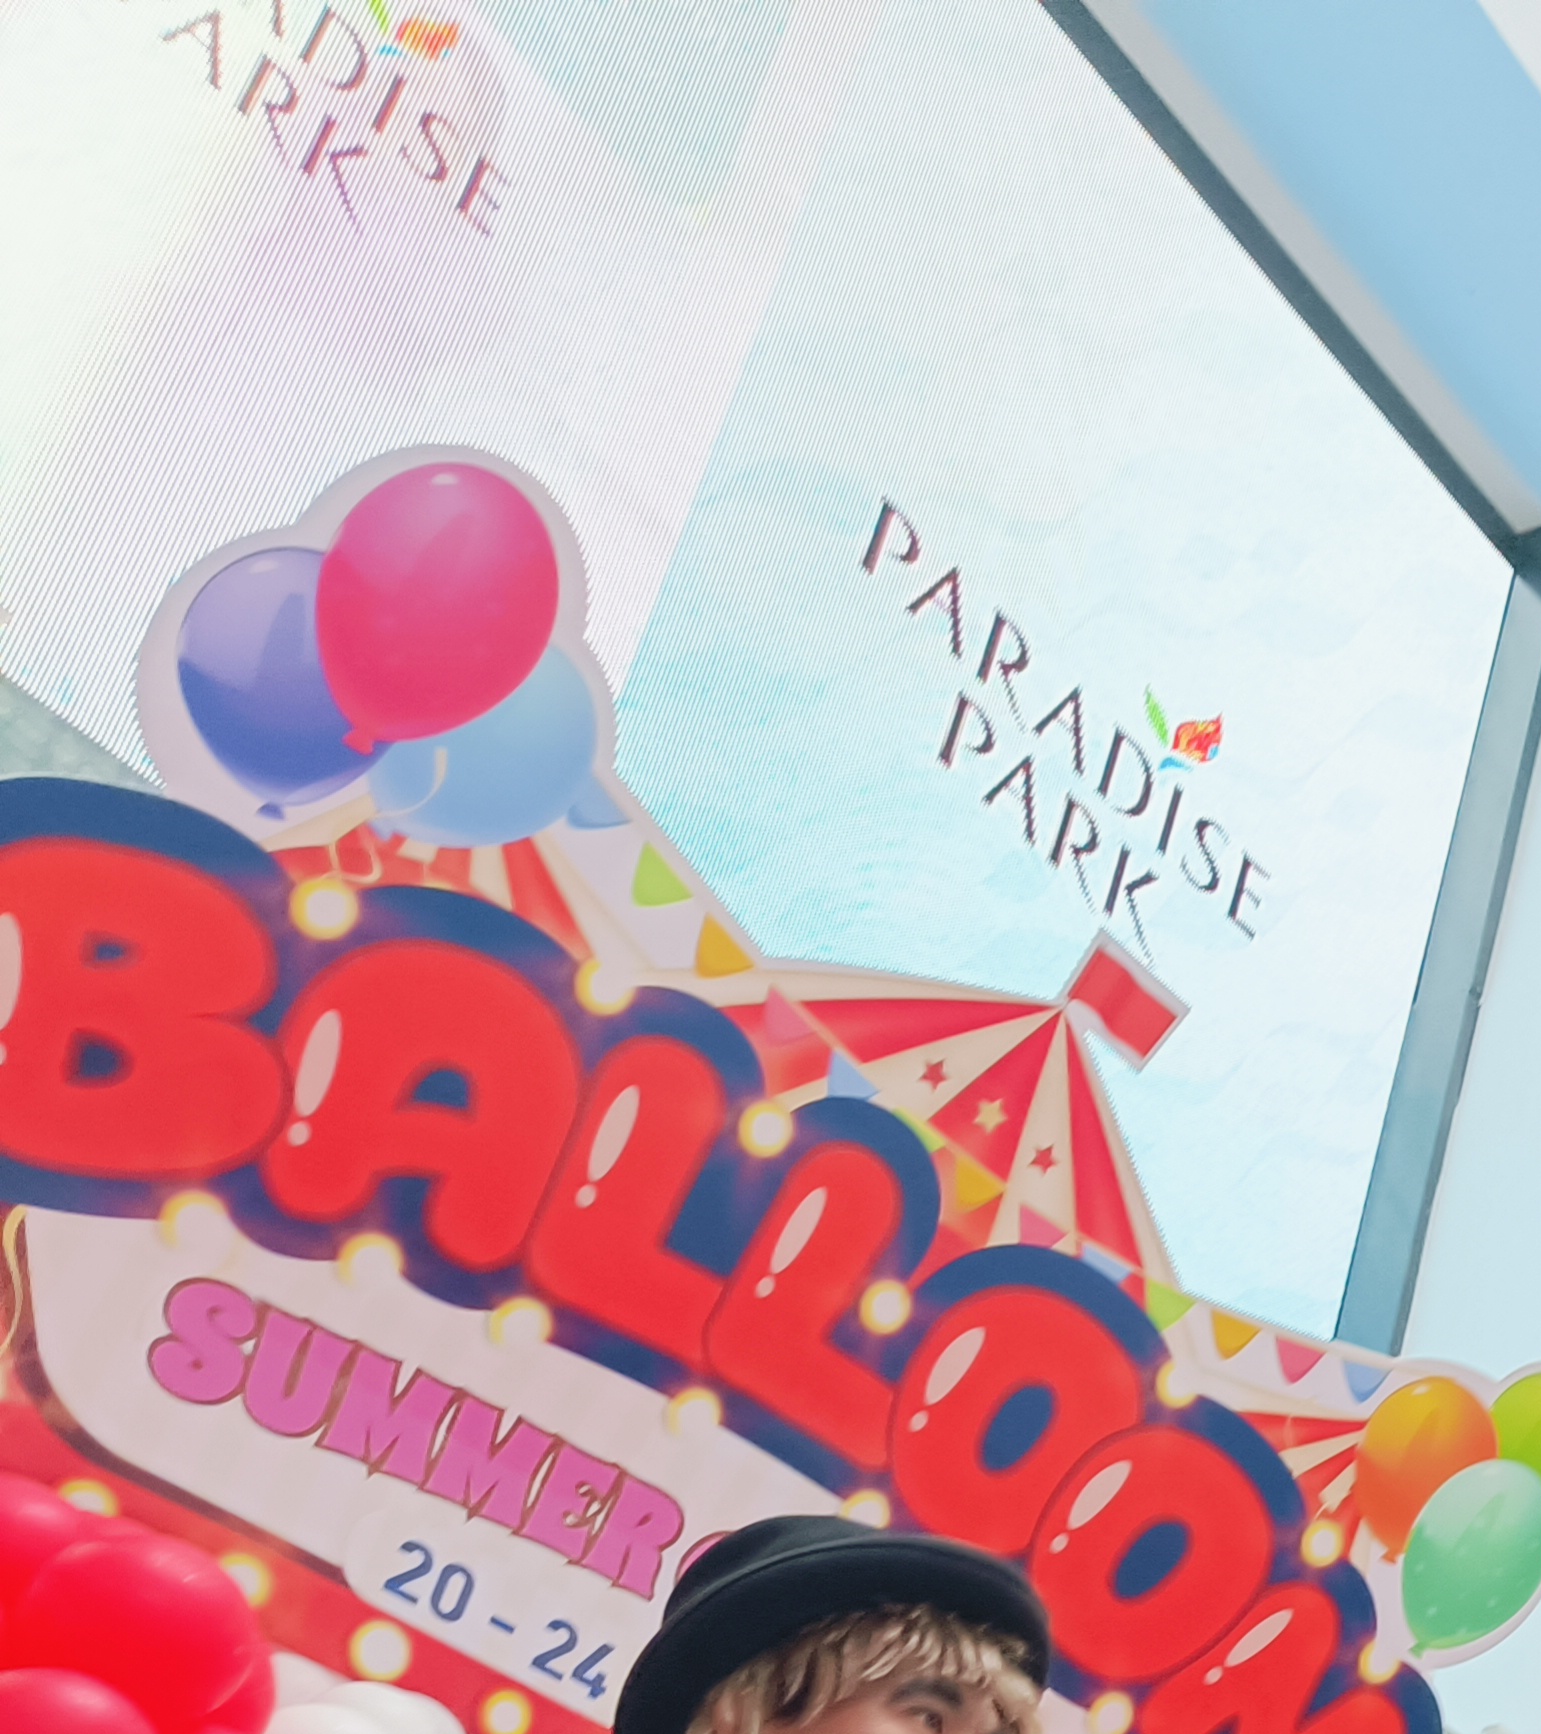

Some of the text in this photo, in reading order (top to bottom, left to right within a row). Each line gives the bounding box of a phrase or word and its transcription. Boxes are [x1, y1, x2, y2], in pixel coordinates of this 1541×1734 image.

[861, 496, 1271, 942] PARADISE
[936, 690, 1155, 966] PARK
[148, 1277, 684, 1602] SUMMER
[382, 1539, 476, 1624] 20
[531, 1617, 617, 1701] 24
